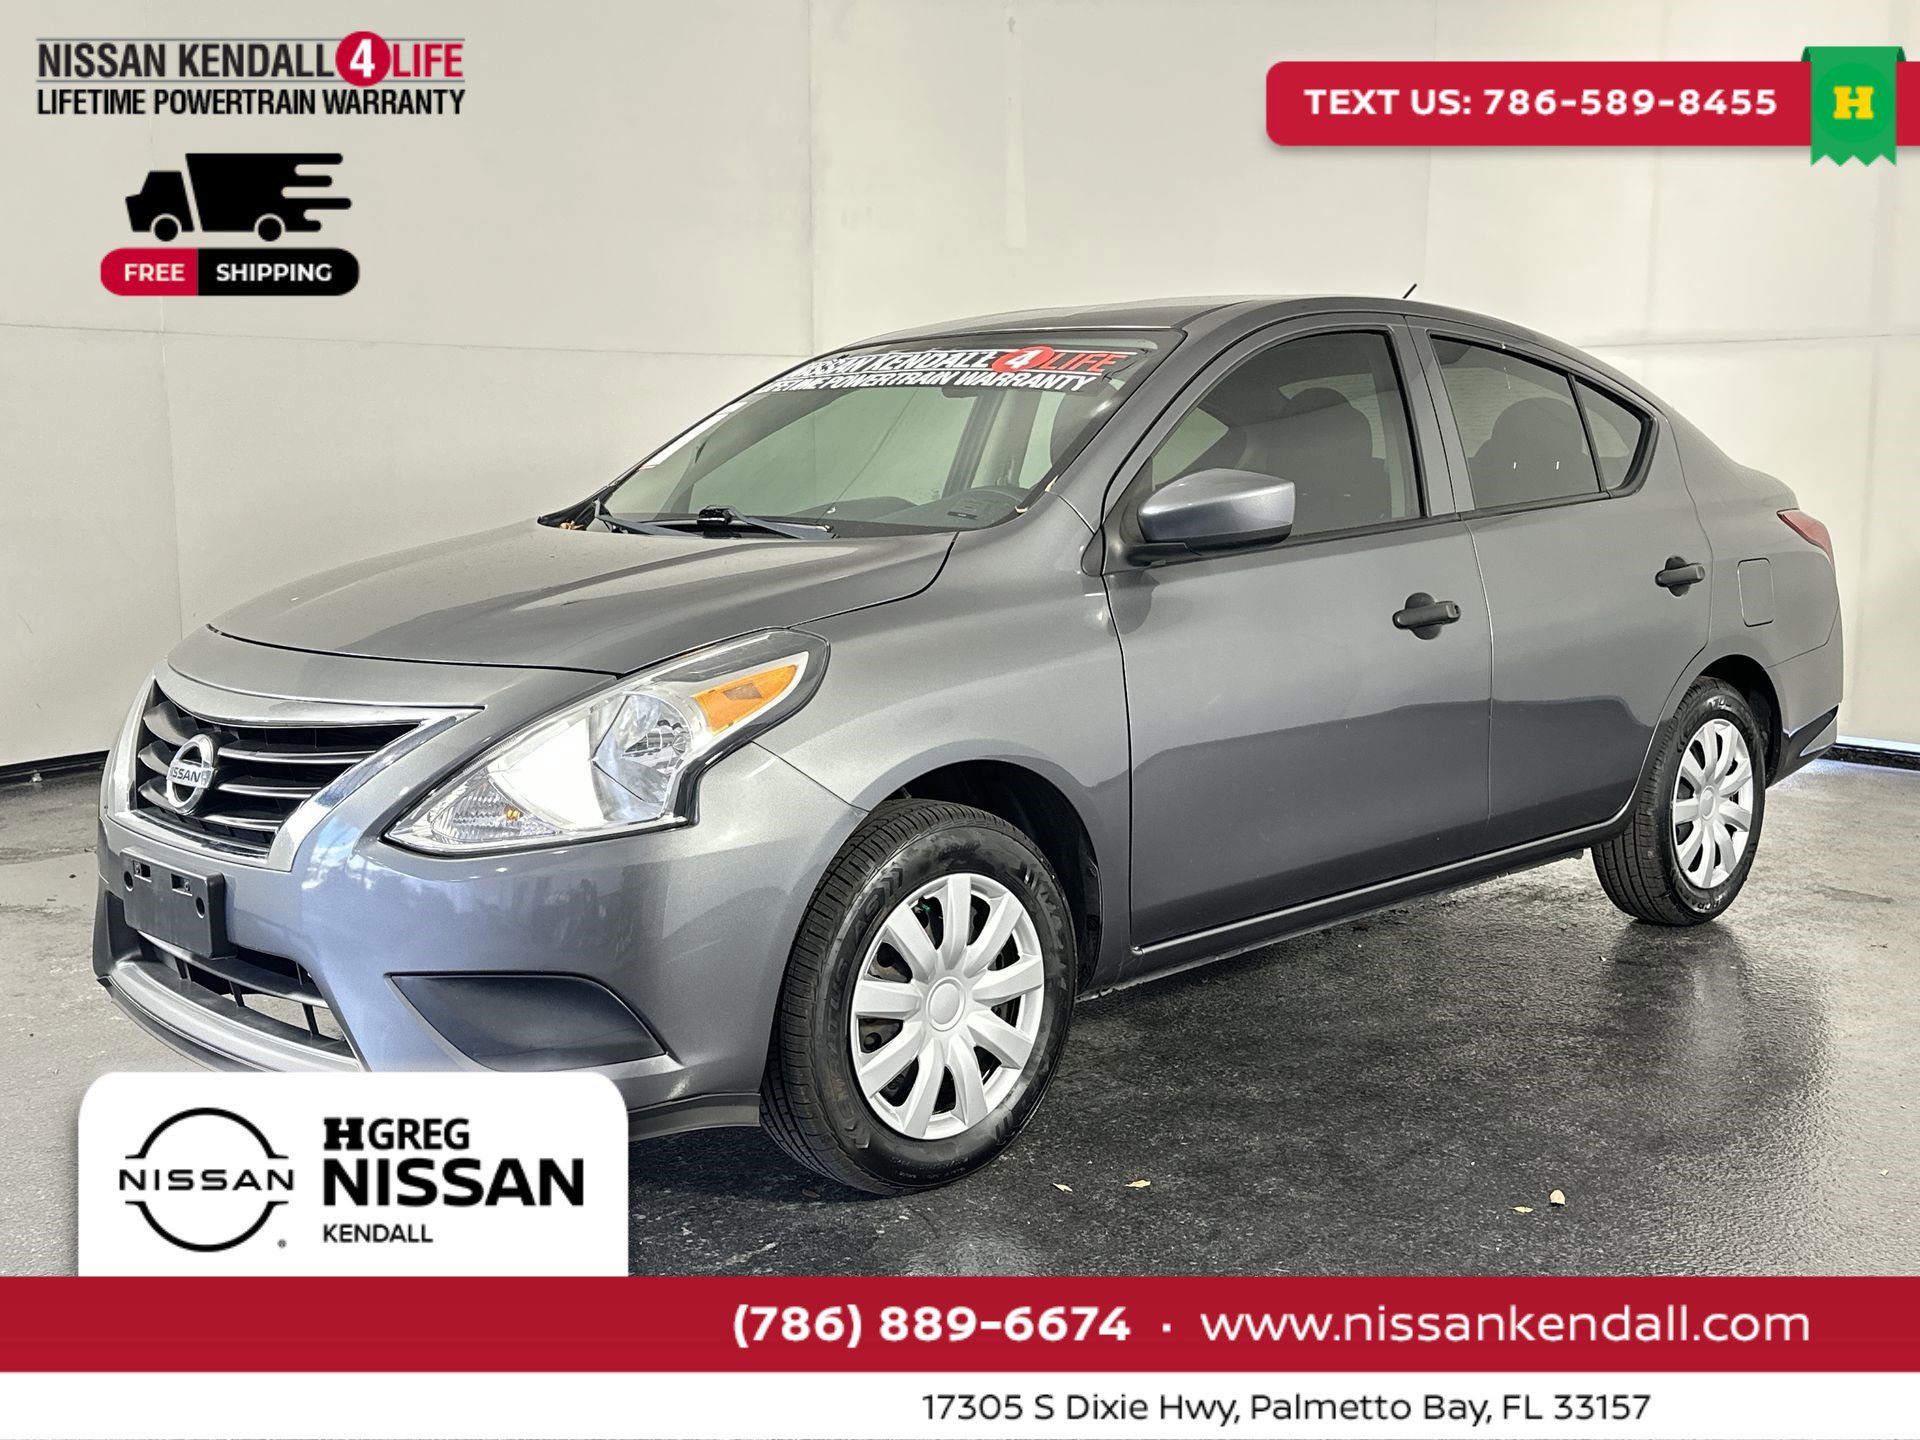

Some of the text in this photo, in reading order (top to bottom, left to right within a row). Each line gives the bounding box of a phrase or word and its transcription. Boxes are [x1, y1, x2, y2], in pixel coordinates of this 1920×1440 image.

[866, 350, 997, 371] KENDALL
[1006, 350, 1042, 369] 4
[1040, 353, 1129, 373] LIFE
[818, 371, 954, 390] POWERTRAIN
[954, 371, 1097, 391] WARRANTY
